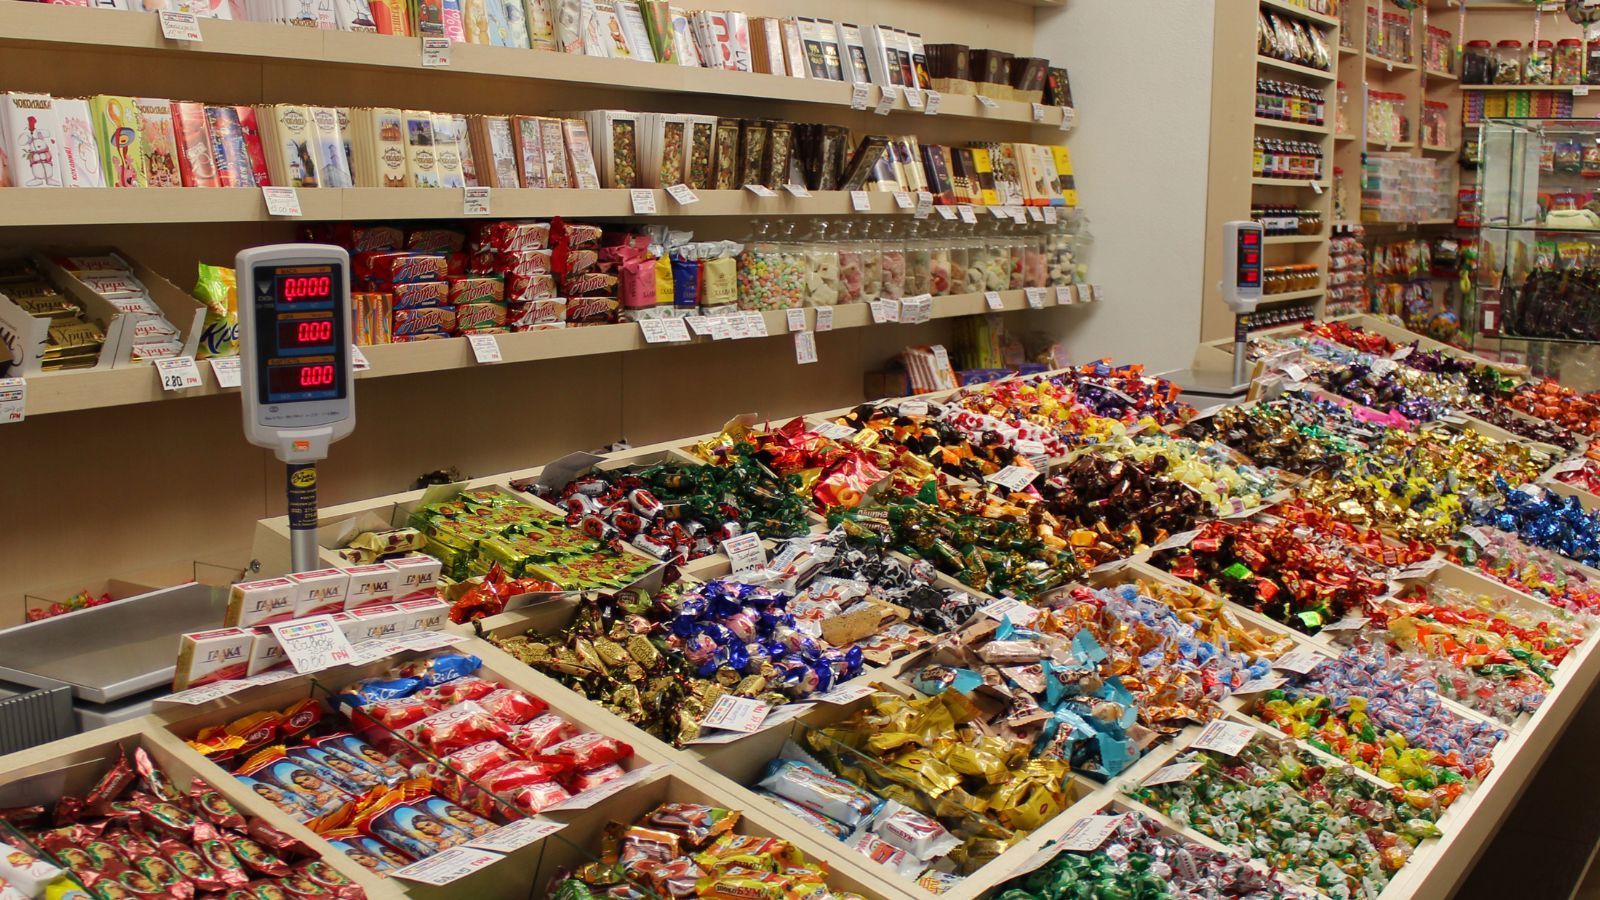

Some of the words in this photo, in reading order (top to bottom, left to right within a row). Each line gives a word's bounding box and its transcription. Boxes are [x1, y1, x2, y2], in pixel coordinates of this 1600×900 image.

[58, 327, 95, 347] Хрум
[298, 321, 332, 342] 0.00
[300, 365, 334, 387] 0.00
